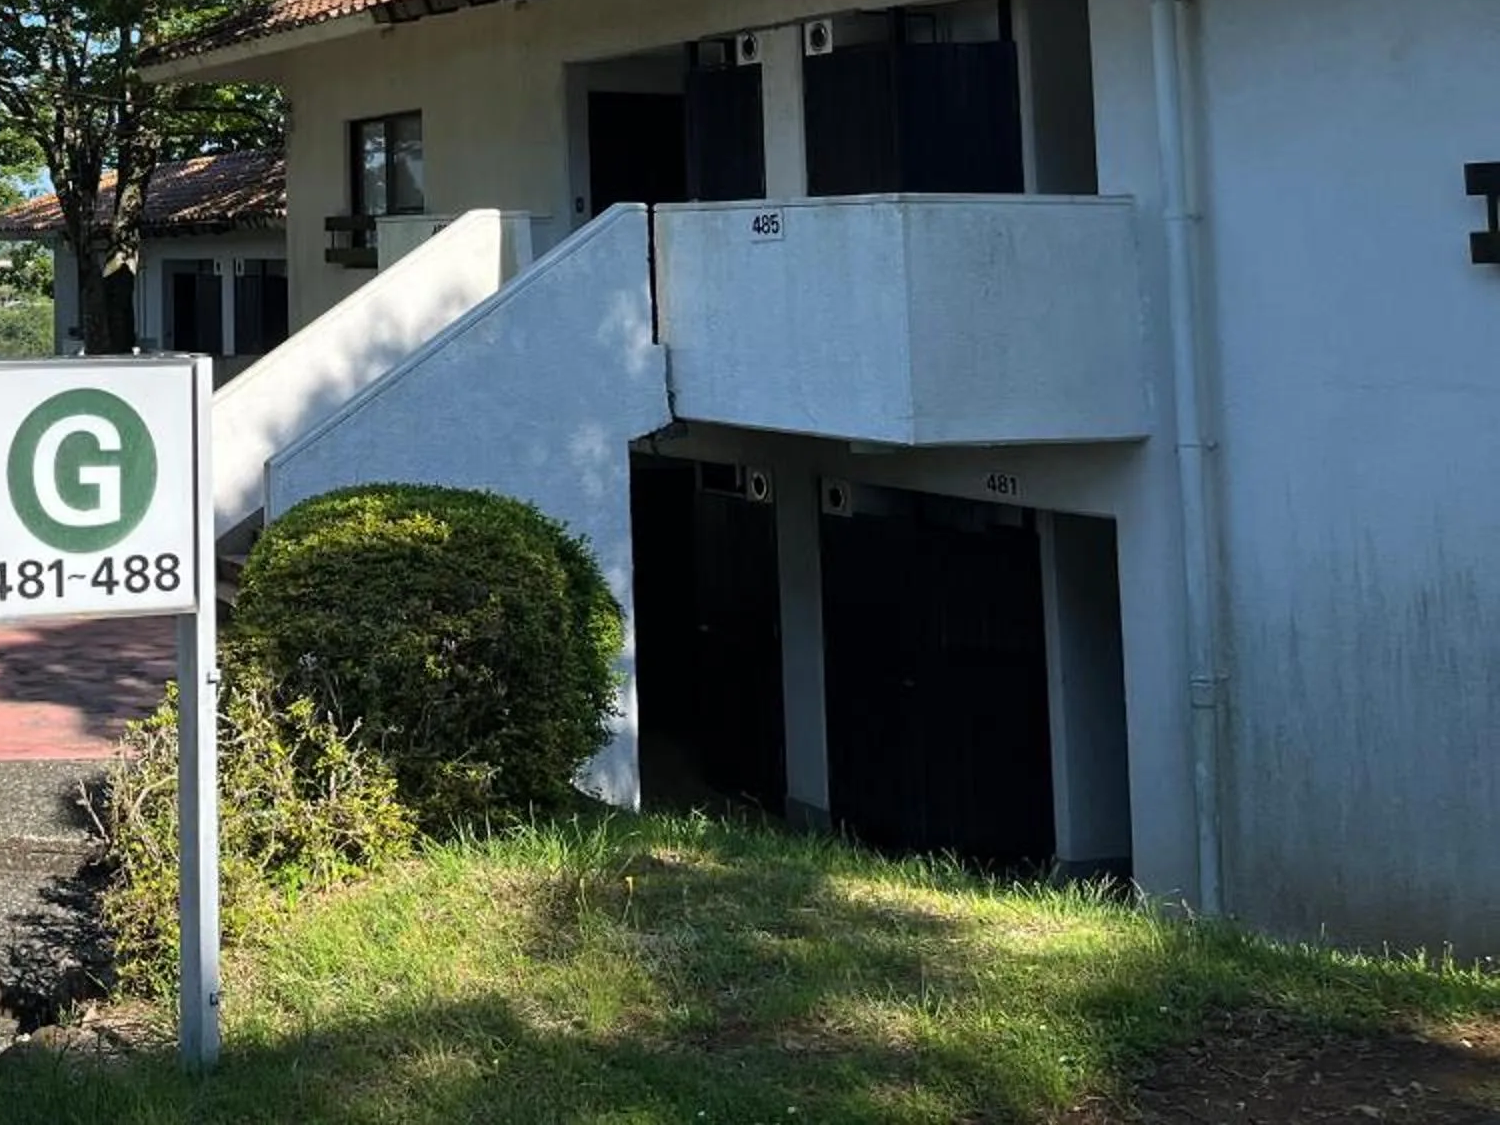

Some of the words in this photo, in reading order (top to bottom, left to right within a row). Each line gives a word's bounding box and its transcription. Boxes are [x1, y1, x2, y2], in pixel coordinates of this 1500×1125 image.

[752, 214, 780, 235] 485
[32, 414, 122, 527] G
[987, 474, 1017, 495] 481
